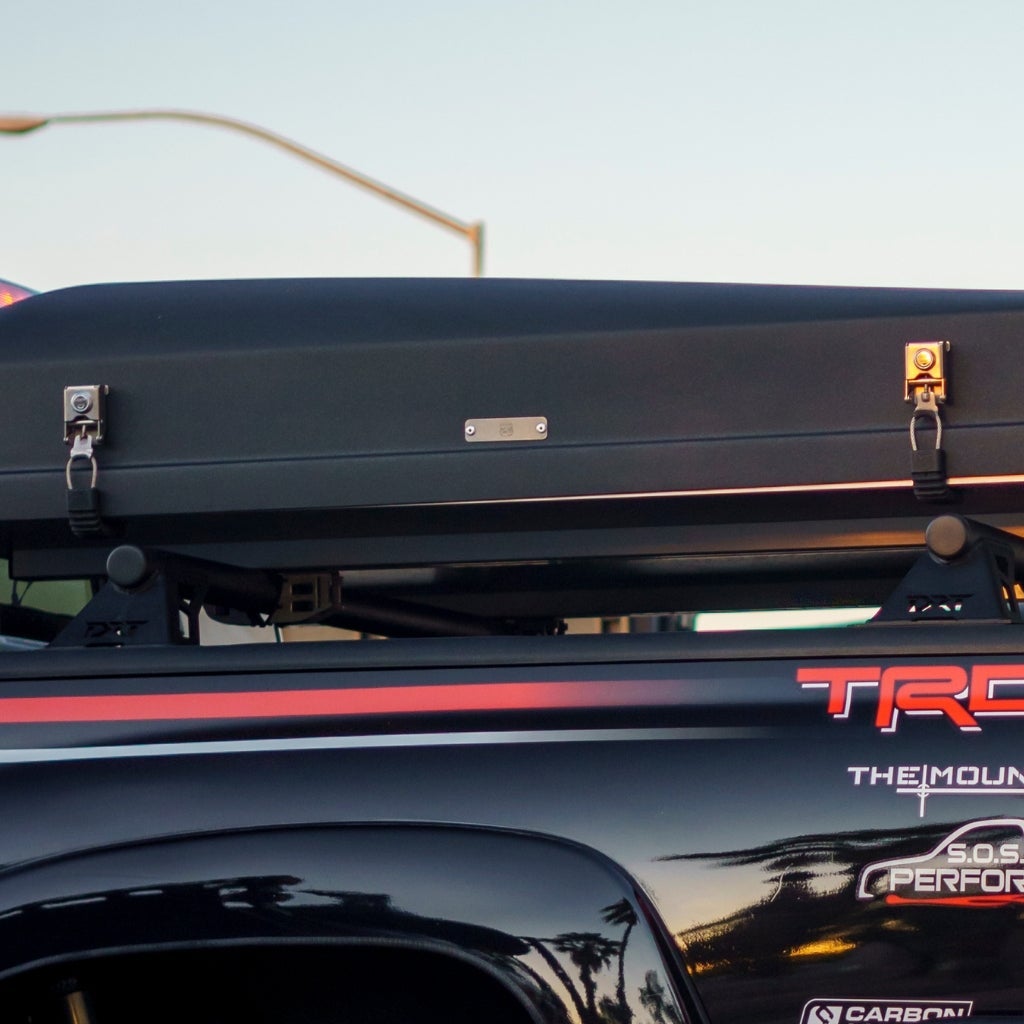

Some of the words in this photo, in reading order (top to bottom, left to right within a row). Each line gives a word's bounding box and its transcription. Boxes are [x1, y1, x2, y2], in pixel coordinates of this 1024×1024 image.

[848, 766, 919, 786] THE
[947, 843, 1024, 864] S.O.S.
[845, 1006, 964, 1022] CARBON
